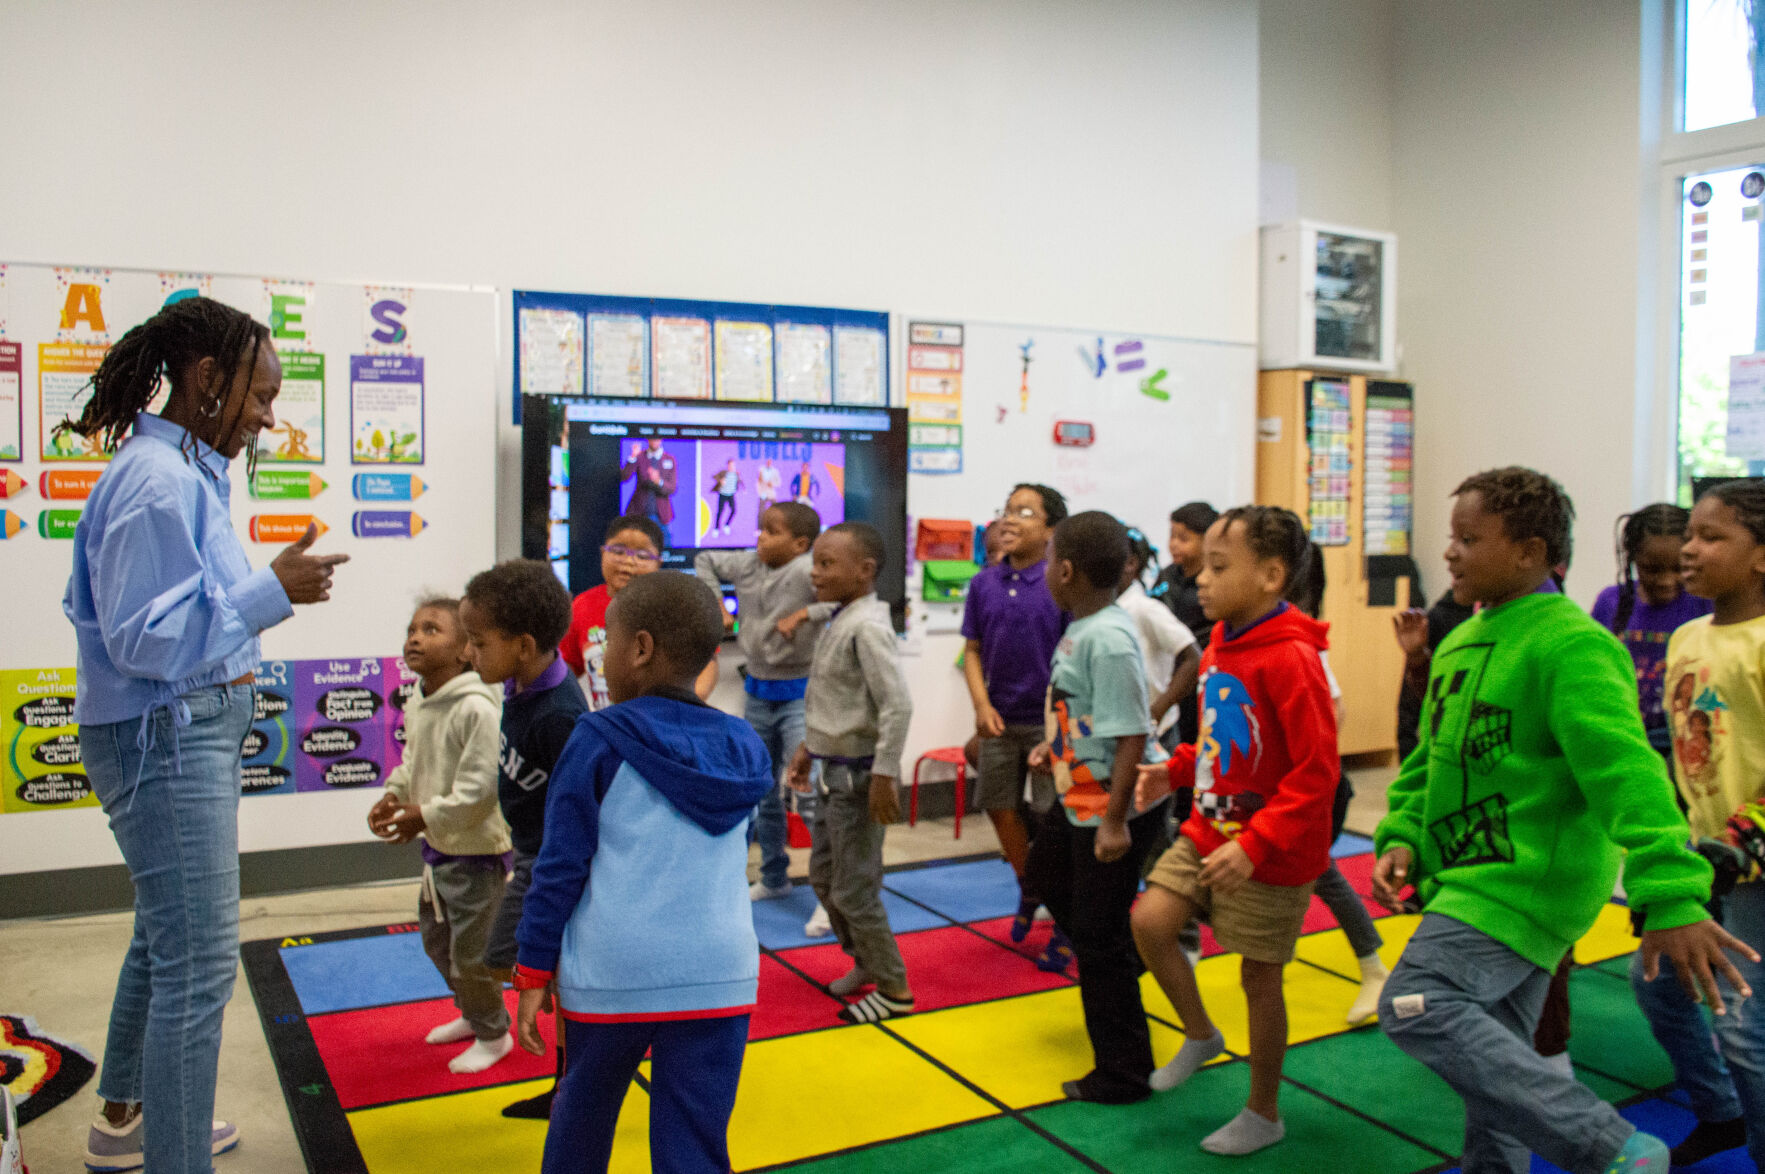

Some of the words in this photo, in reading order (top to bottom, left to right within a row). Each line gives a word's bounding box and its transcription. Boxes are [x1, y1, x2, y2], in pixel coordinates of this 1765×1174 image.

[59, 283, 107, 332] A
[271, 294, 306, 339] E
[370, 299, 408, 345] S
[328, 661, 351, 672] Use
[37, 669, 61, 682] Ask
[313, 671, 364, 685] Evidence
[17, 682, 77, 694] Question
[41, 697, 59, 706] Ask
[326, 709, 373, 722] Opinion
[58, 735, 75, 743] Ask
[303, 740, 356, 753] Evidence
[46, 773, 63, 782] Ask
[325, 771, 377, 784] Evidence
[24, 788, 89, 802] Challenge
